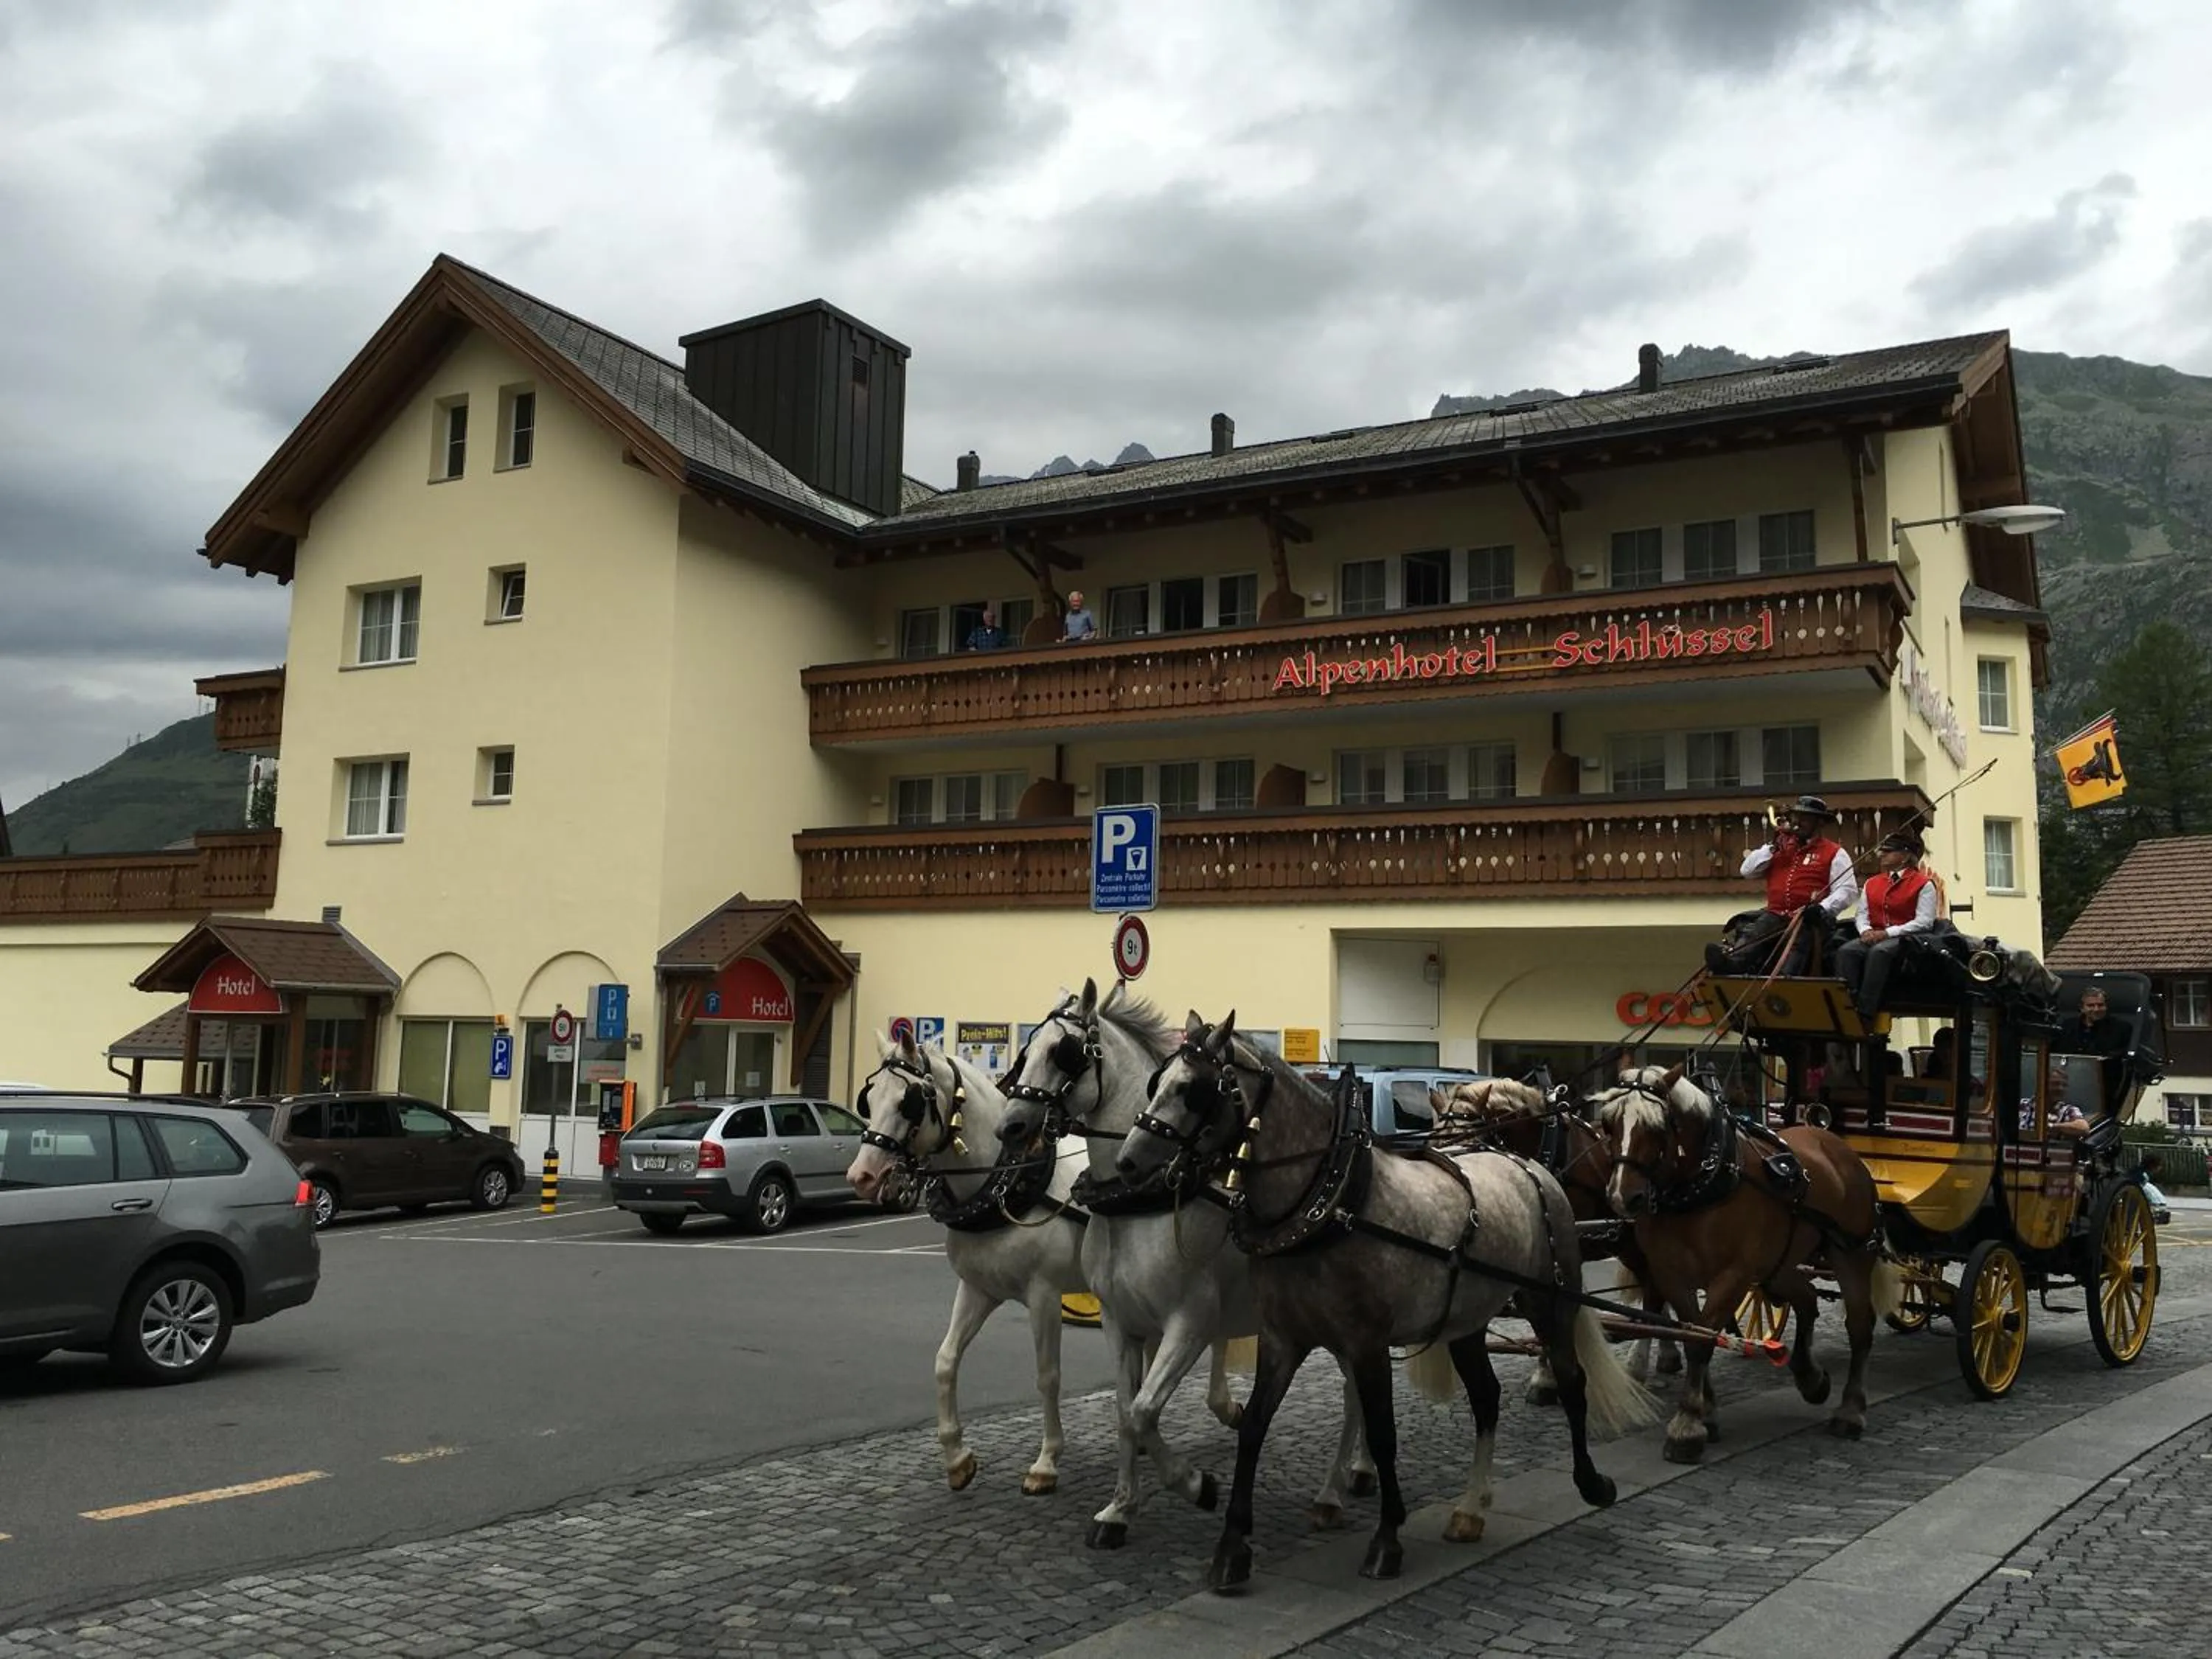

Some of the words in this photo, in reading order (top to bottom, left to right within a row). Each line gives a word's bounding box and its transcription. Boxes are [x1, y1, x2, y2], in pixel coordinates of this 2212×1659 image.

[1272, 635, 1496, 695] Alpenhotel
[1551, 608, 1773, 667] Schlüssel
[1102, 815, 1136, 863] P
[218, 974, 255, 995] Hotel
[608, 989, 617, 1004] P
[751, 995, 788, 1016] Hotel
[495, 1040, 507, 1060] P
